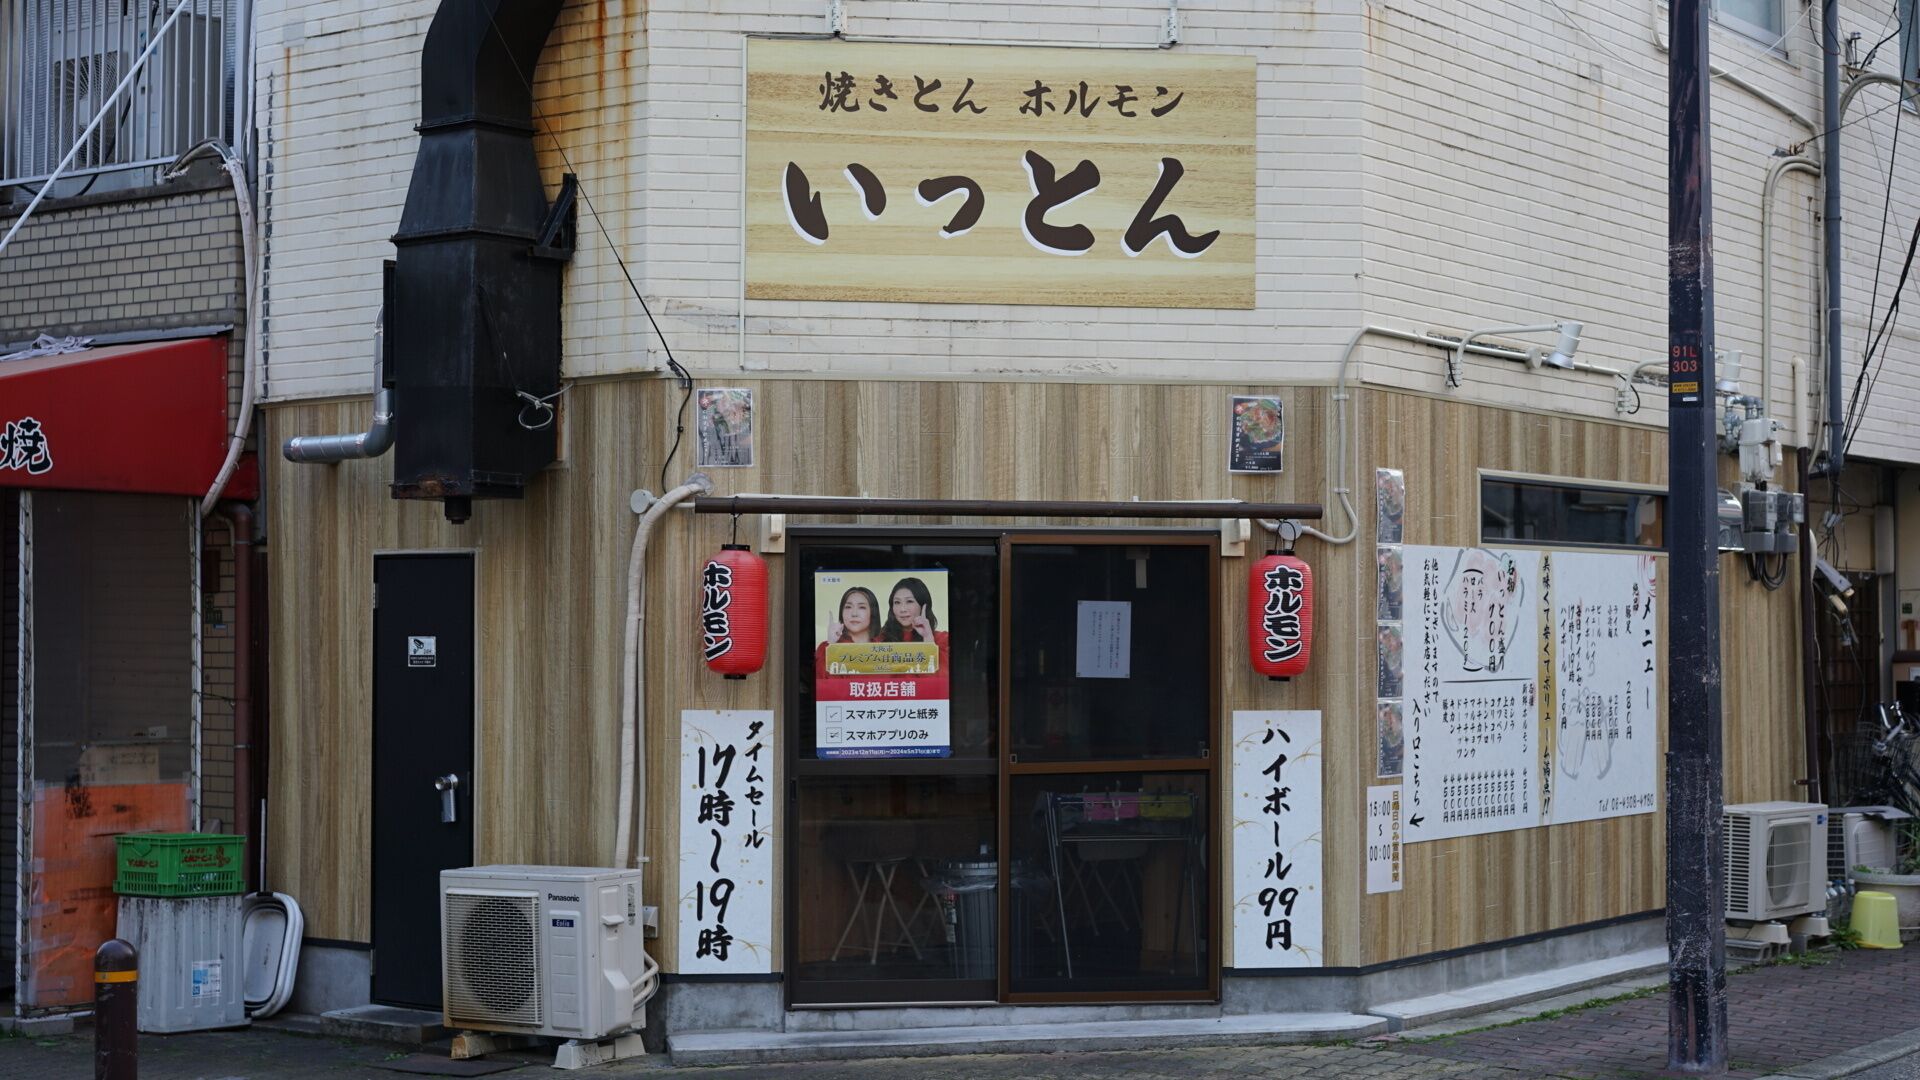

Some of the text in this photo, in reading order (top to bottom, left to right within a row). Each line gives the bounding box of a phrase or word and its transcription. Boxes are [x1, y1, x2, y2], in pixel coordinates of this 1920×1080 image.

[818, 71, 1185, 119] 焼きとん ホルモン
[782, 149, 1221, 258] いっとん
[1672, 360, 1697, 373] 303
[0, 417, 53, 475] 焼
[703, 561, 732, 661] ホルモン
[1263, 564, 1303, 662] ホルモン
[1423, 559, 1431, 717] お気軽にご来店ください
[1431, 558, 1439, 702] 他にもございますので
[1489, 603, 1497, 672] 700円
[1497, 571, 1506, 671] いっとん盛り
[839, 652, 926, 664] プレミアム付商品券
[1642, 597, 1654, 710] メニュー
[846, 708, 939, 720] スマホアプリと紙券
[849, 681, 916, 697] 取扱店舗
[846, 730, 929, 741] スマホアプリのみ
[1412, 698, 1421, 806] 入り口こちら
[744, 720, 765, 849] タイムセール
[1369, 800, 1391, 817] 15:00
[1257, 728, 1299, 951] ハイボール99円
[1369, 844, 1391, 861] 00:00
[548, 893, 580, 902] Panasonic
